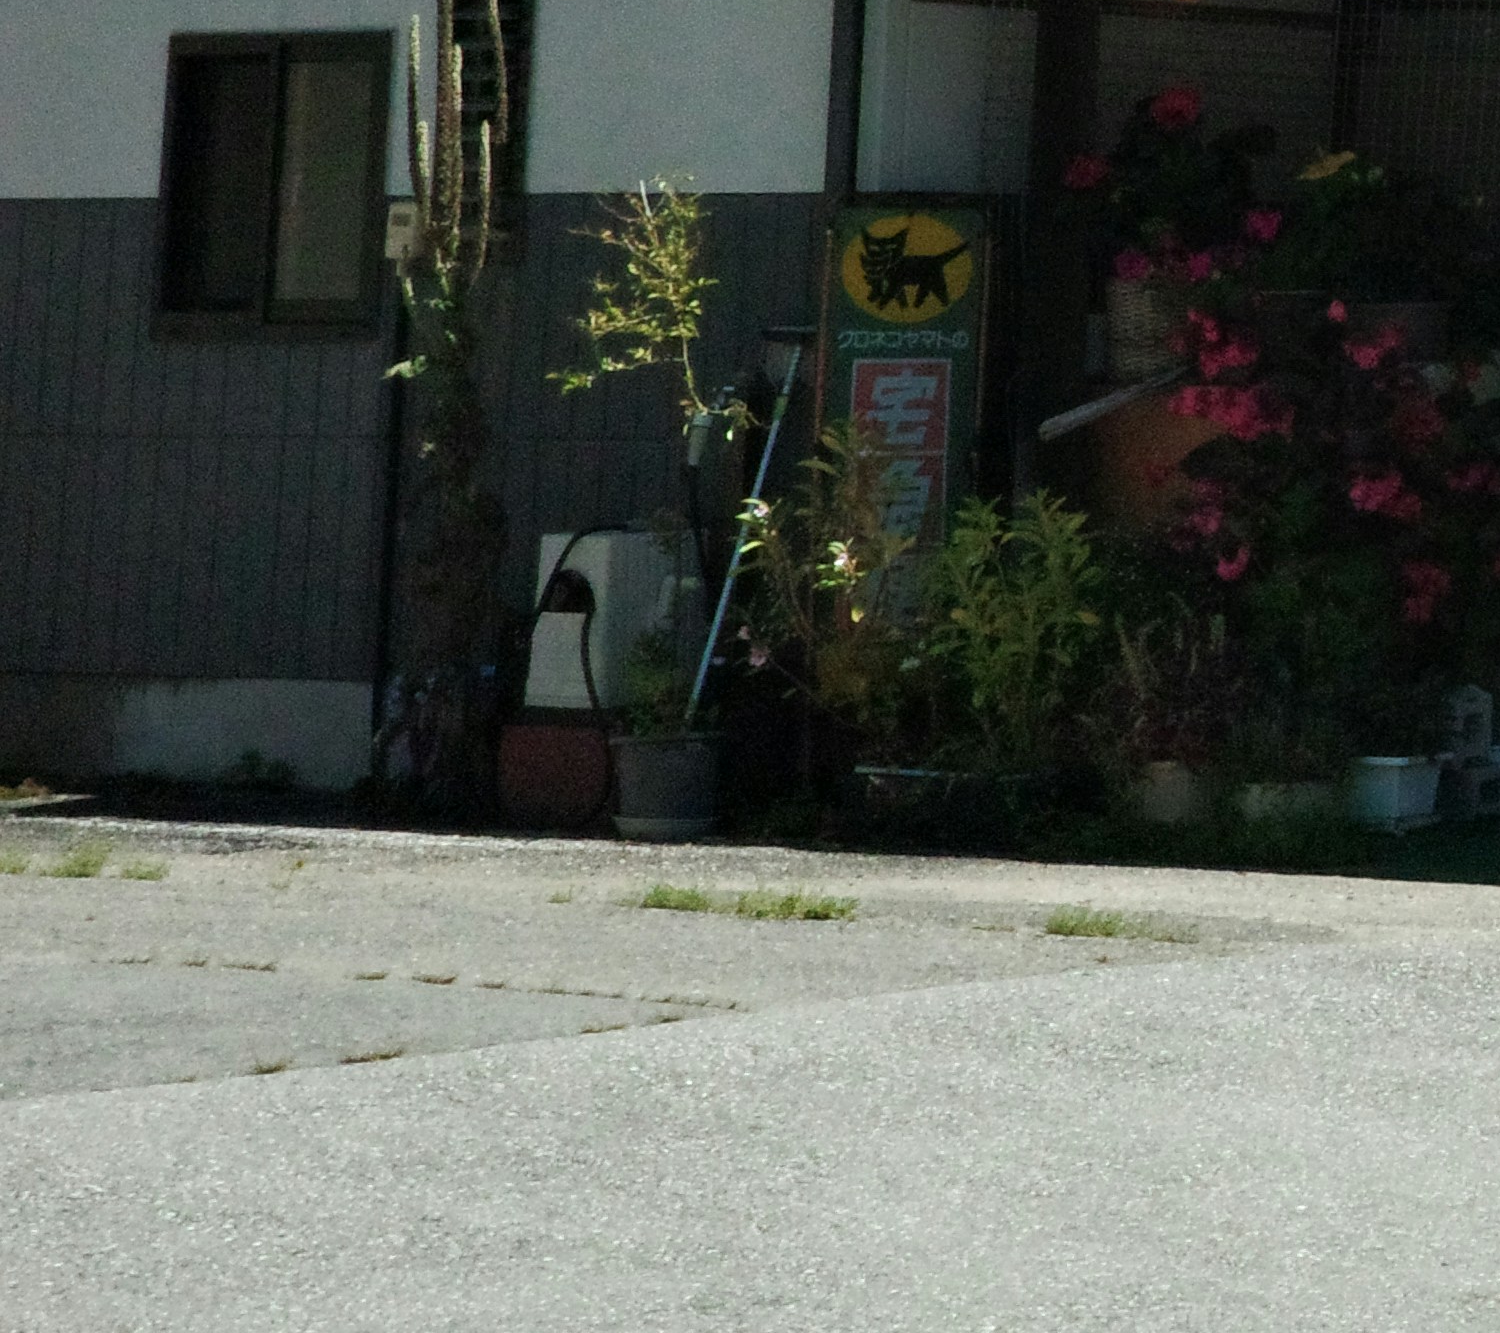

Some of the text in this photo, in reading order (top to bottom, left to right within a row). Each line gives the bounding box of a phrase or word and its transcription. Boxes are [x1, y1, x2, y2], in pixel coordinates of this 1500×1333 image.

[837, 330, 970, 350] クロネコヤマトの
